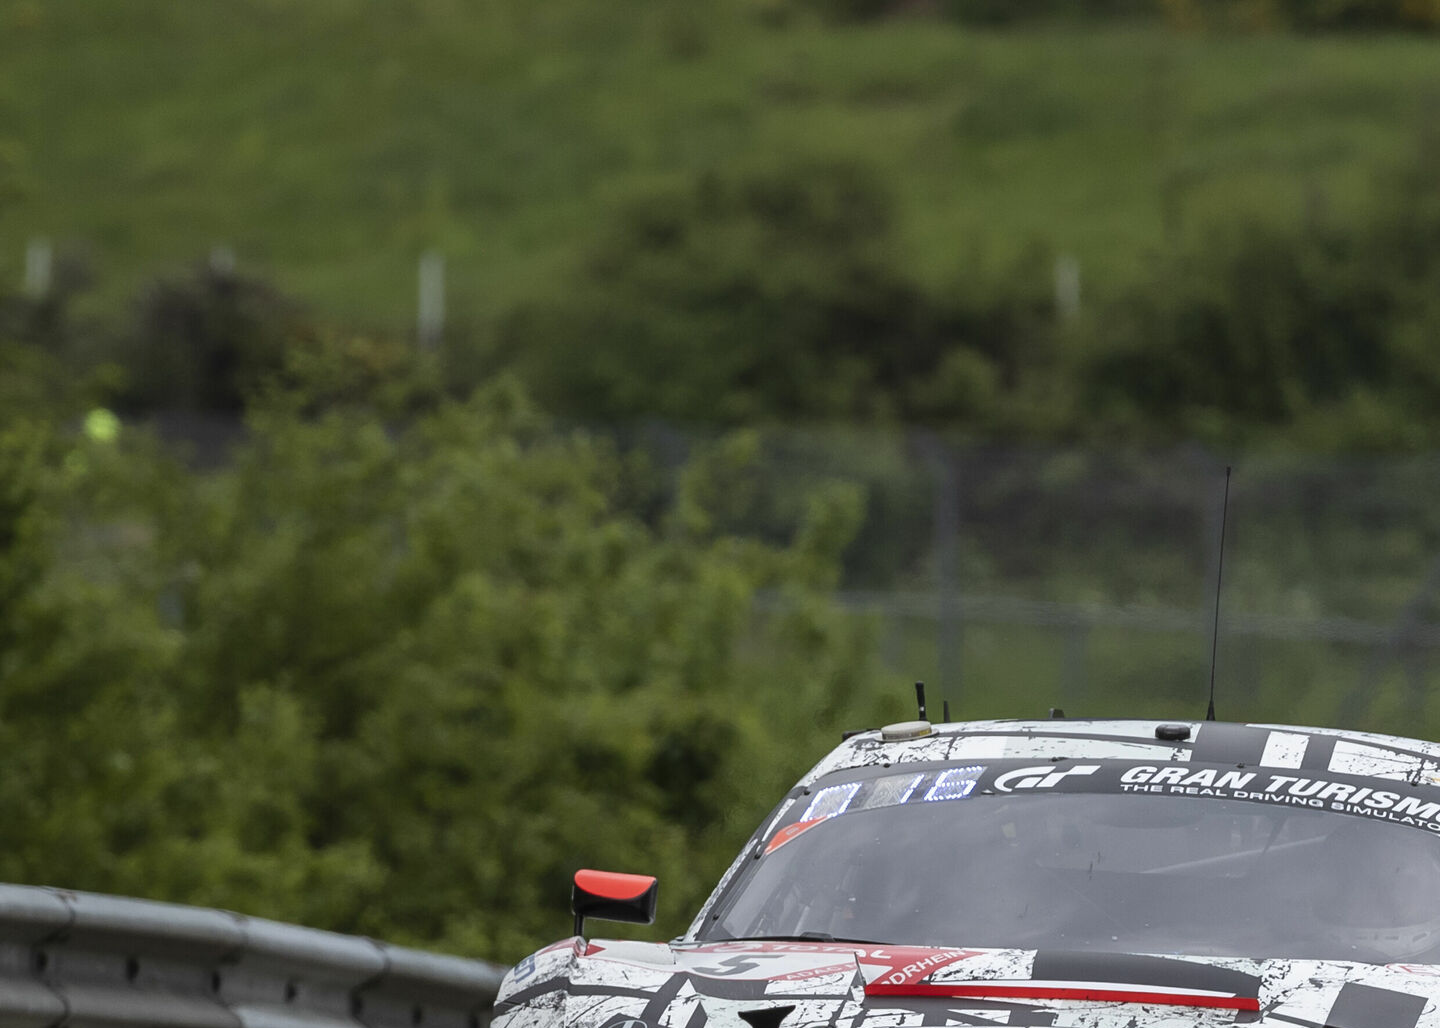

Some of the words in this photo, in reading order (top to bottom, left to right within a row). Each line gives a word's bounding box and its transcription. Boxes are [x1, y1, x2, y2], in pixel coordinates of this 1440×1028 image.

[1120, 766, 1257, 790] GRAN
[1120, 784, 1163, 793] THE
[1170, 785, 1227, 797] REAL
[1233, 791, 1324, 809] DRIVING
[772, 944, 892, 960] TOTAL
